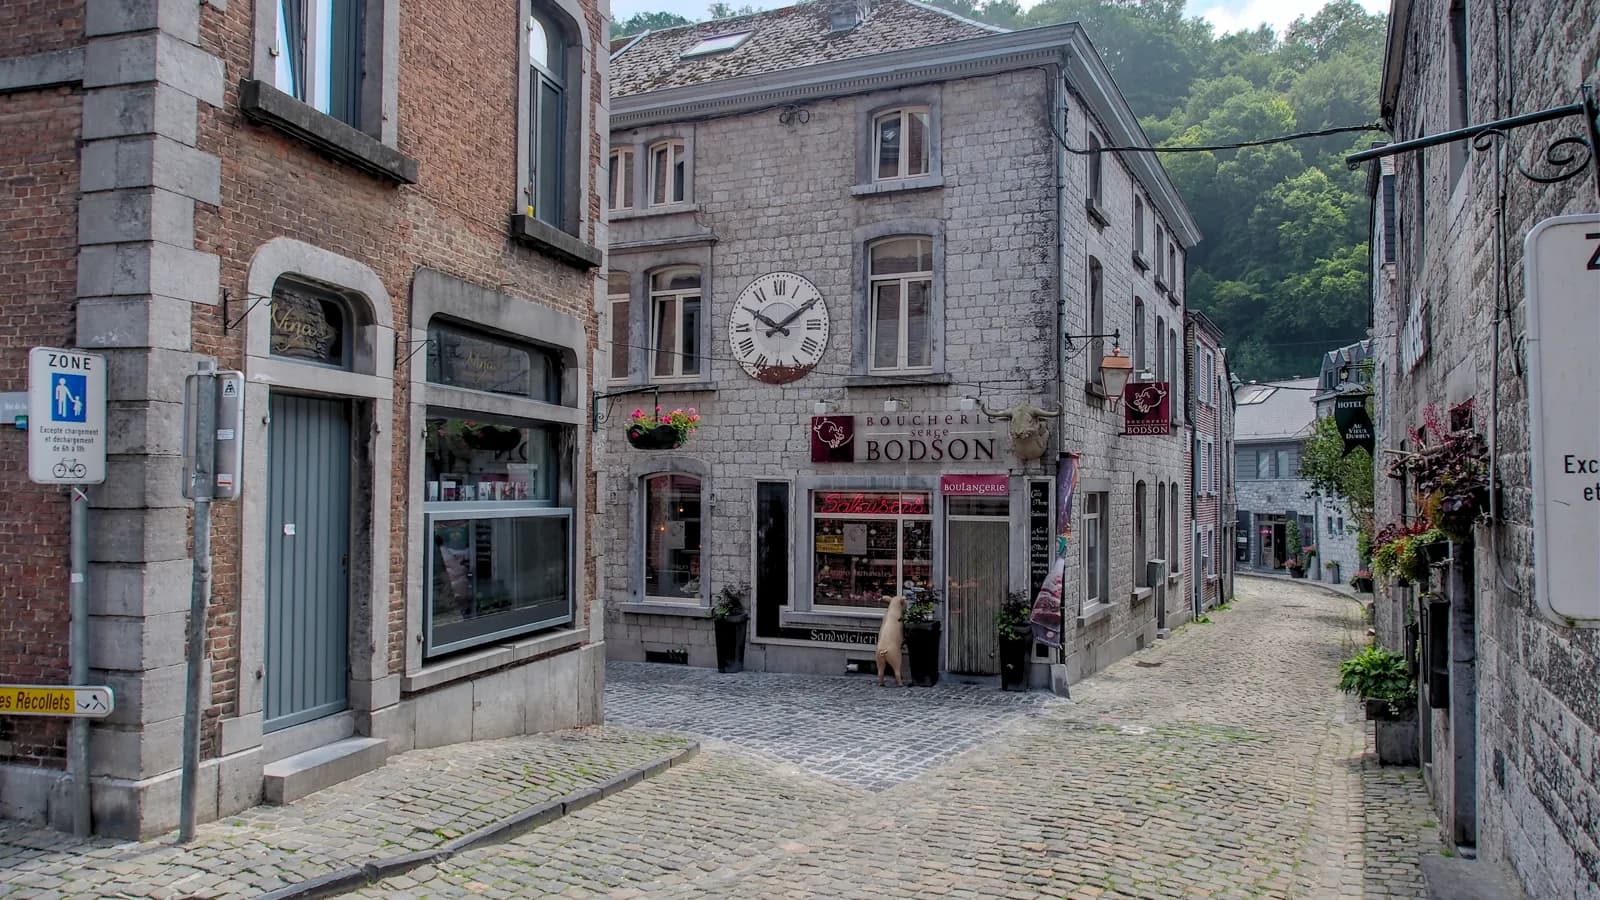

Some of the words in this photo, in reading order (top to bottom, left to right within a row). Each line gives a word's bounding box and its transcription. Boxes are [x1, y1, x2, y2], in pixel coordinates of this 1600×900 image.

[48, 353, 92, 371] ZONE
[1127, 426, 1168, 434] BODSON
[866, 438, 996, 461] BODSON
[16, 691, 70, 711] Récollets
